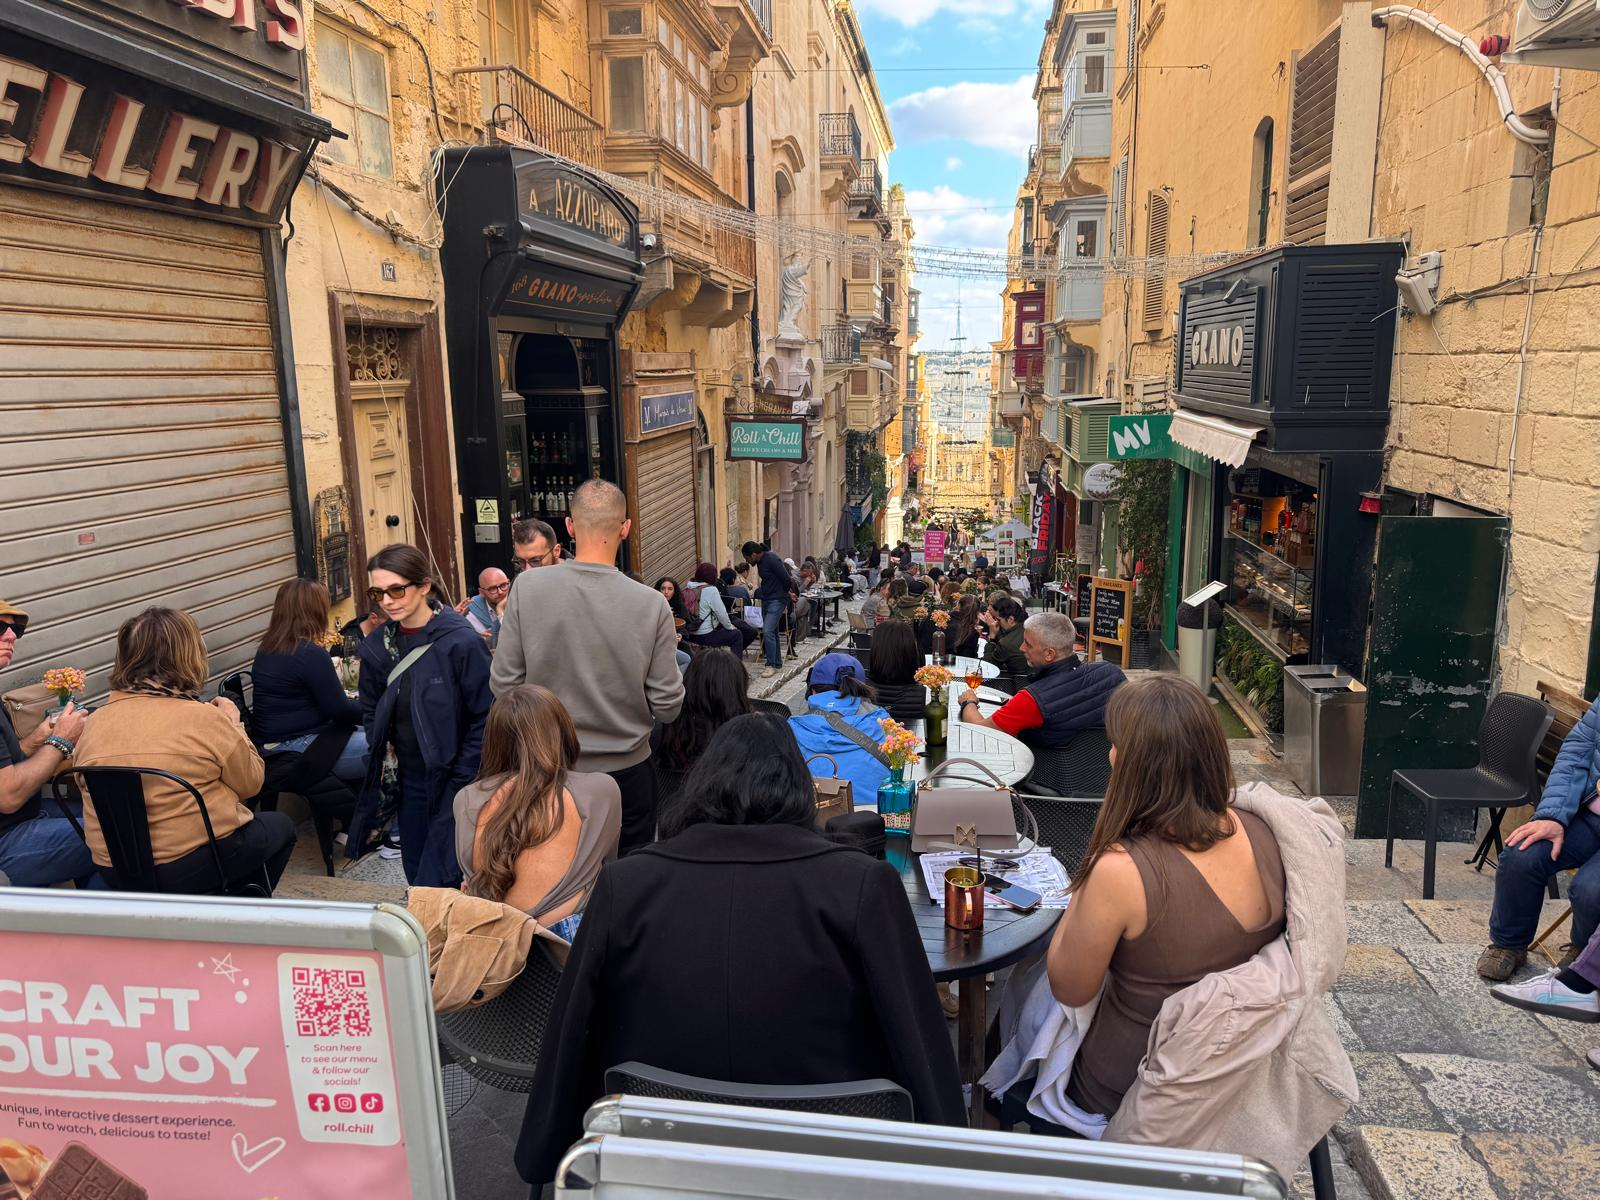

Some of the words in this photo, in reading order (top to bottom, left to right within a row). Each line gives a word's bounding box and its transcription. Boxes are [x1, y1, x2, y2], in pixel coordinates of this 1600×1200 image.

[555, 177, 626, 244] AZZOPARDI
[528, 278, 578, 303] GRANO
[1191, 325, 1244, 367] GRANO
[732, 426, 760, 444] Roll
[761, 434, 767, 442] &
[765, 427, 801, 445] Chill
[1113, 419, 1151, 456] MV
[1031, 493, 1044, 550] BLACK
[1037, 490, 1052, 551] FRIDAY
[0, 979, 200, 1031] CRAFT
[313, 1044, 338, 1052] Scan
[340, 1044, 362, 1052] here
[134, 1041, 260, 1085] JOY
[322, 1066, 351, 1074] follow
[324, 1078, 361, 1086] socials!
[0, 1103, 42, 1117] unique,
[44, 1106, 110, 1122] interactive
[112, 1112, 160, 1125] dessert
[161, 1115, 236, 1128] experience.
[18, 1117, 40, 1129] Fun
[42, 1121, 54, 1131] to
[57, 1123, 97, 1136] watch,
[99, 1125, 155, 1138] delicious
[158, 1130, 171, 1140] to
[173, 1130, 211, 1141] taste!
[324, 1123, 374, 1134] roll.chill
